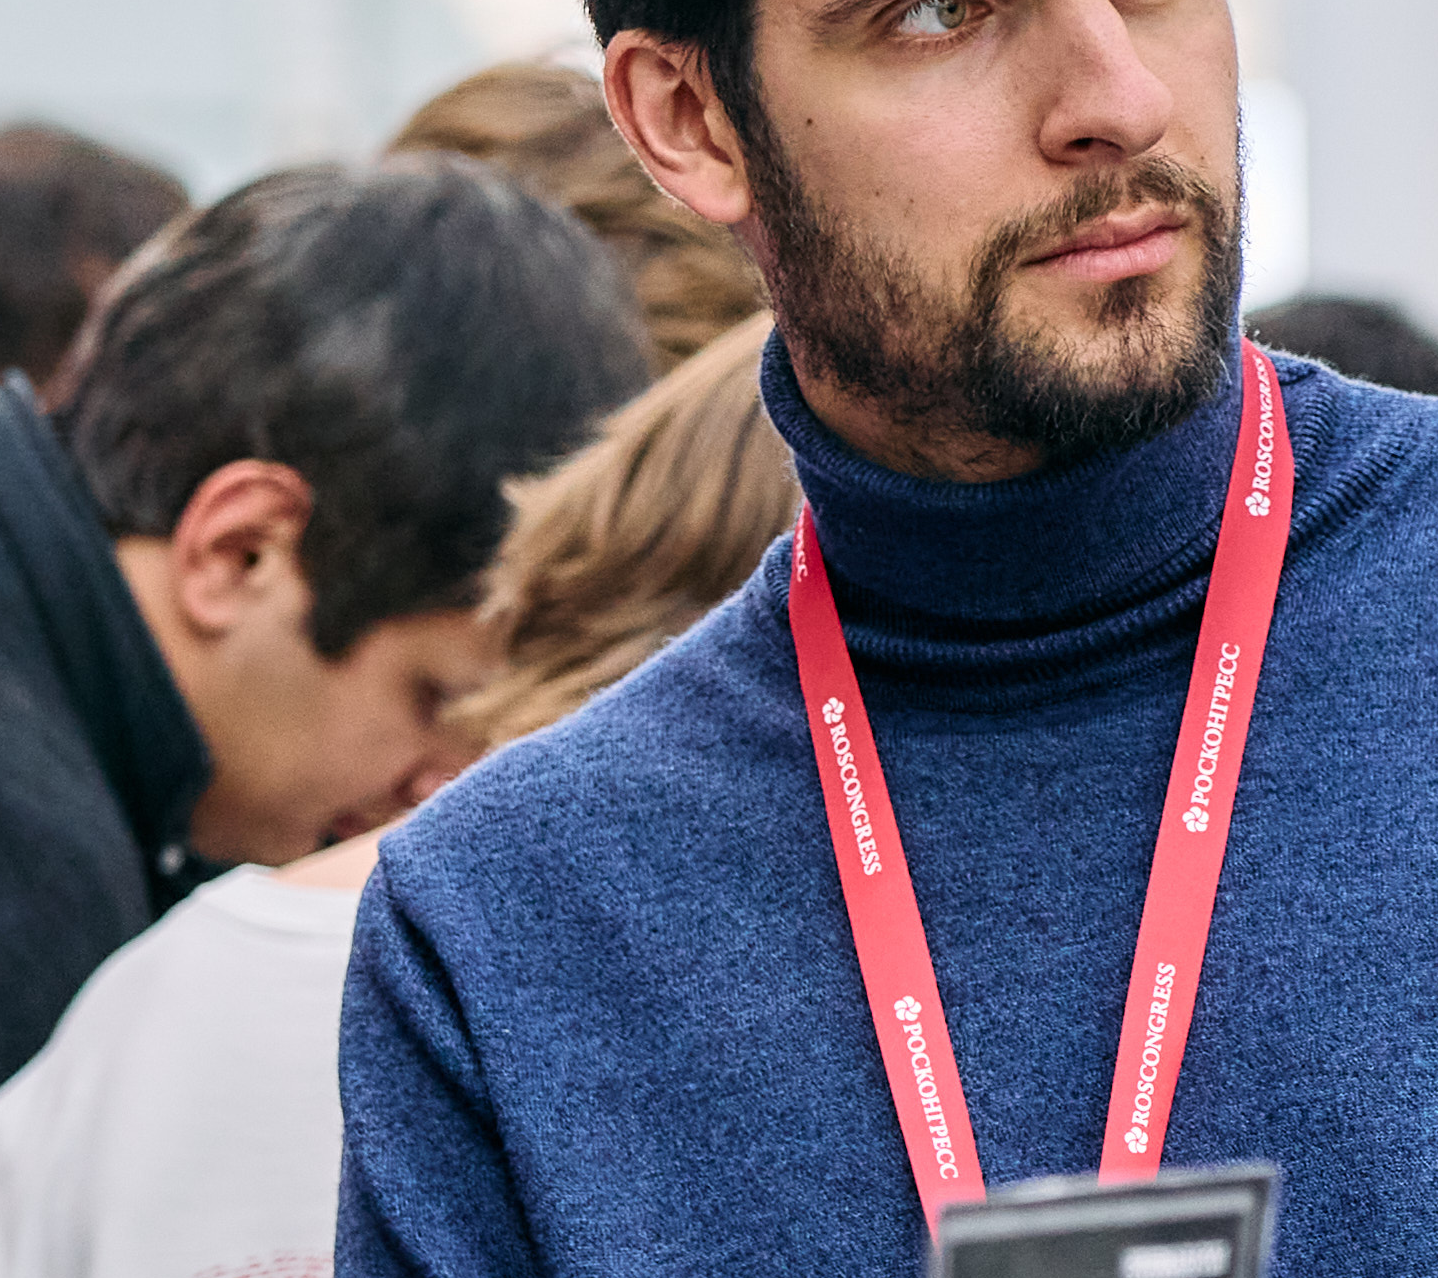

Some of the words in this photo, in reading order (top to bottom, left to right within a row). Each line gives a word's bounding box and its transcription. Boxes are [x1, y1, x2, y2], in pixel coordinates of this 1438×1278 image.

[830, 722, 882, 876] ROSCONGRESS
[1191, 642, 1241, 807] РОСКОНГРЕСС
[903, 1022, 959, 1180] РОСКОНГРЕСС
[1132, 962, 1177, 1128] ROSCONGRESS
